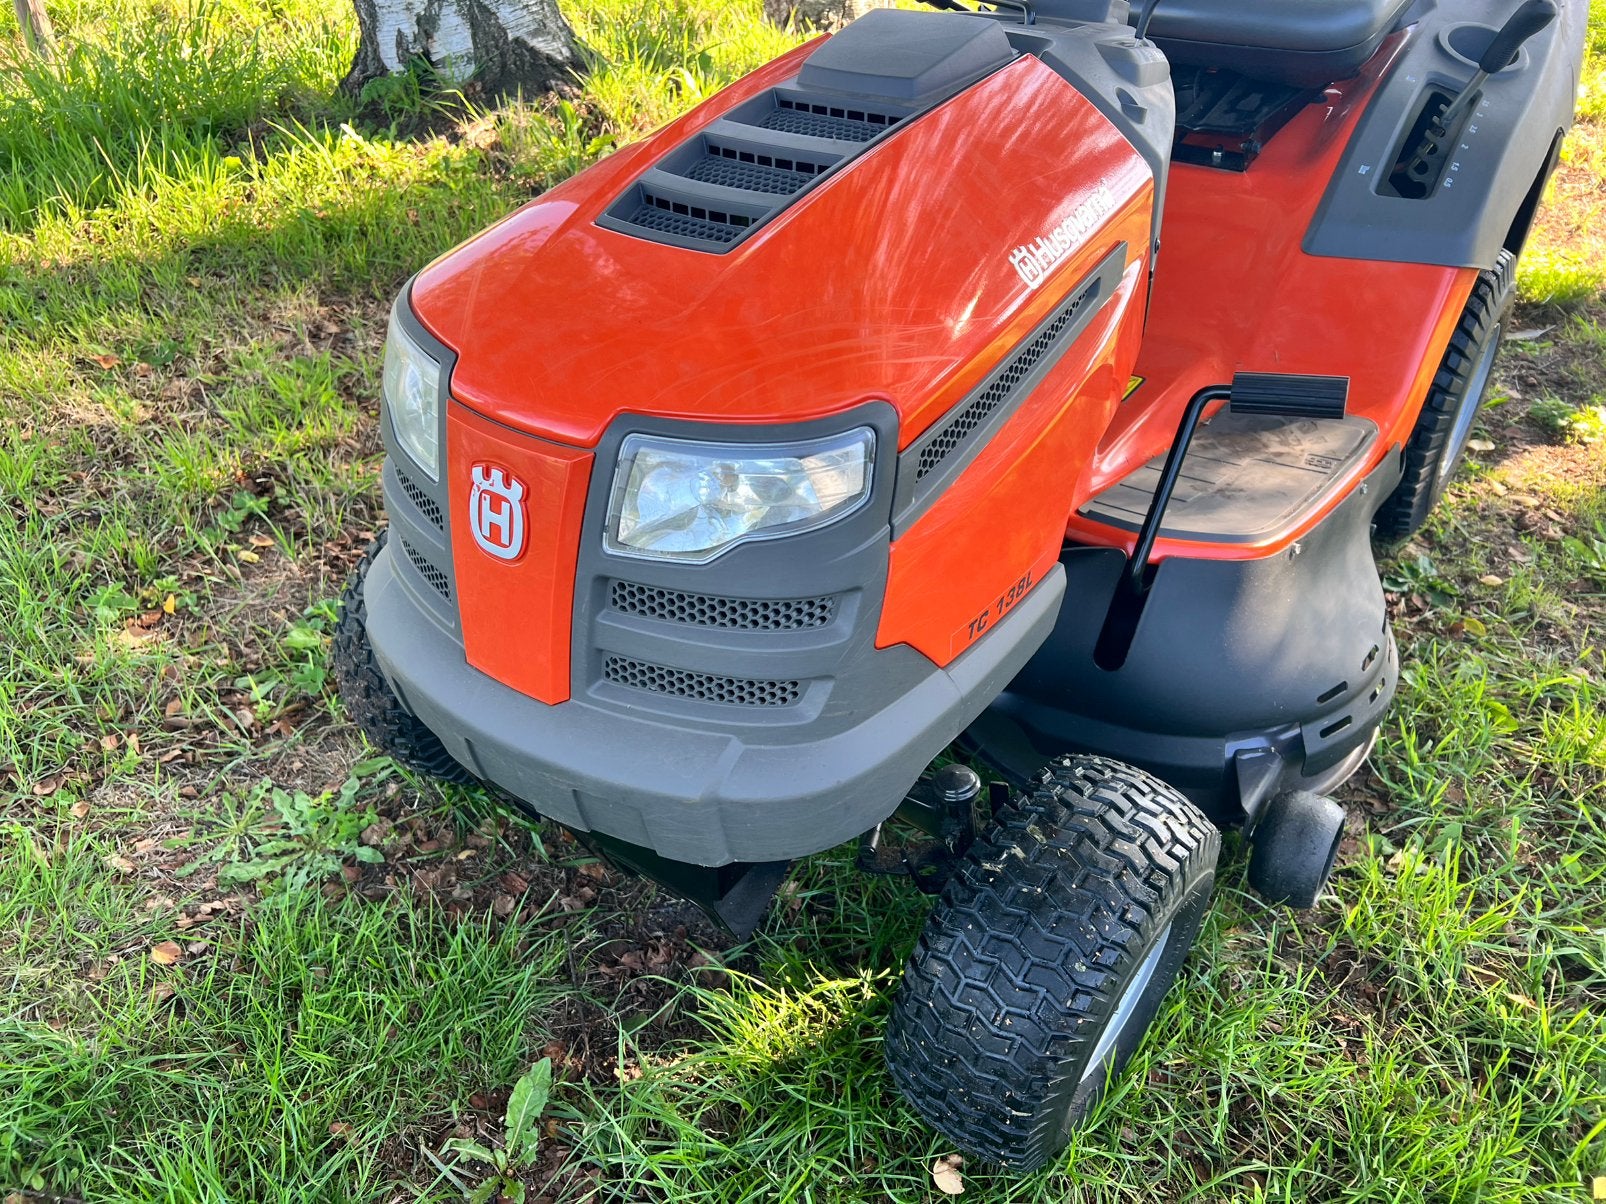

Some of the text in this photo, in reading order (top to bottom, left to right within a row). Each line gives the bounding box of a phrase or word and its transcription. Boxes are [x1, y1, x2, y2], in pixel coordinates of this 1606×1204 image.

[1028, 187, 1116, 272] Husqvarna
[968, 570, 1033, 640] TC 138L
